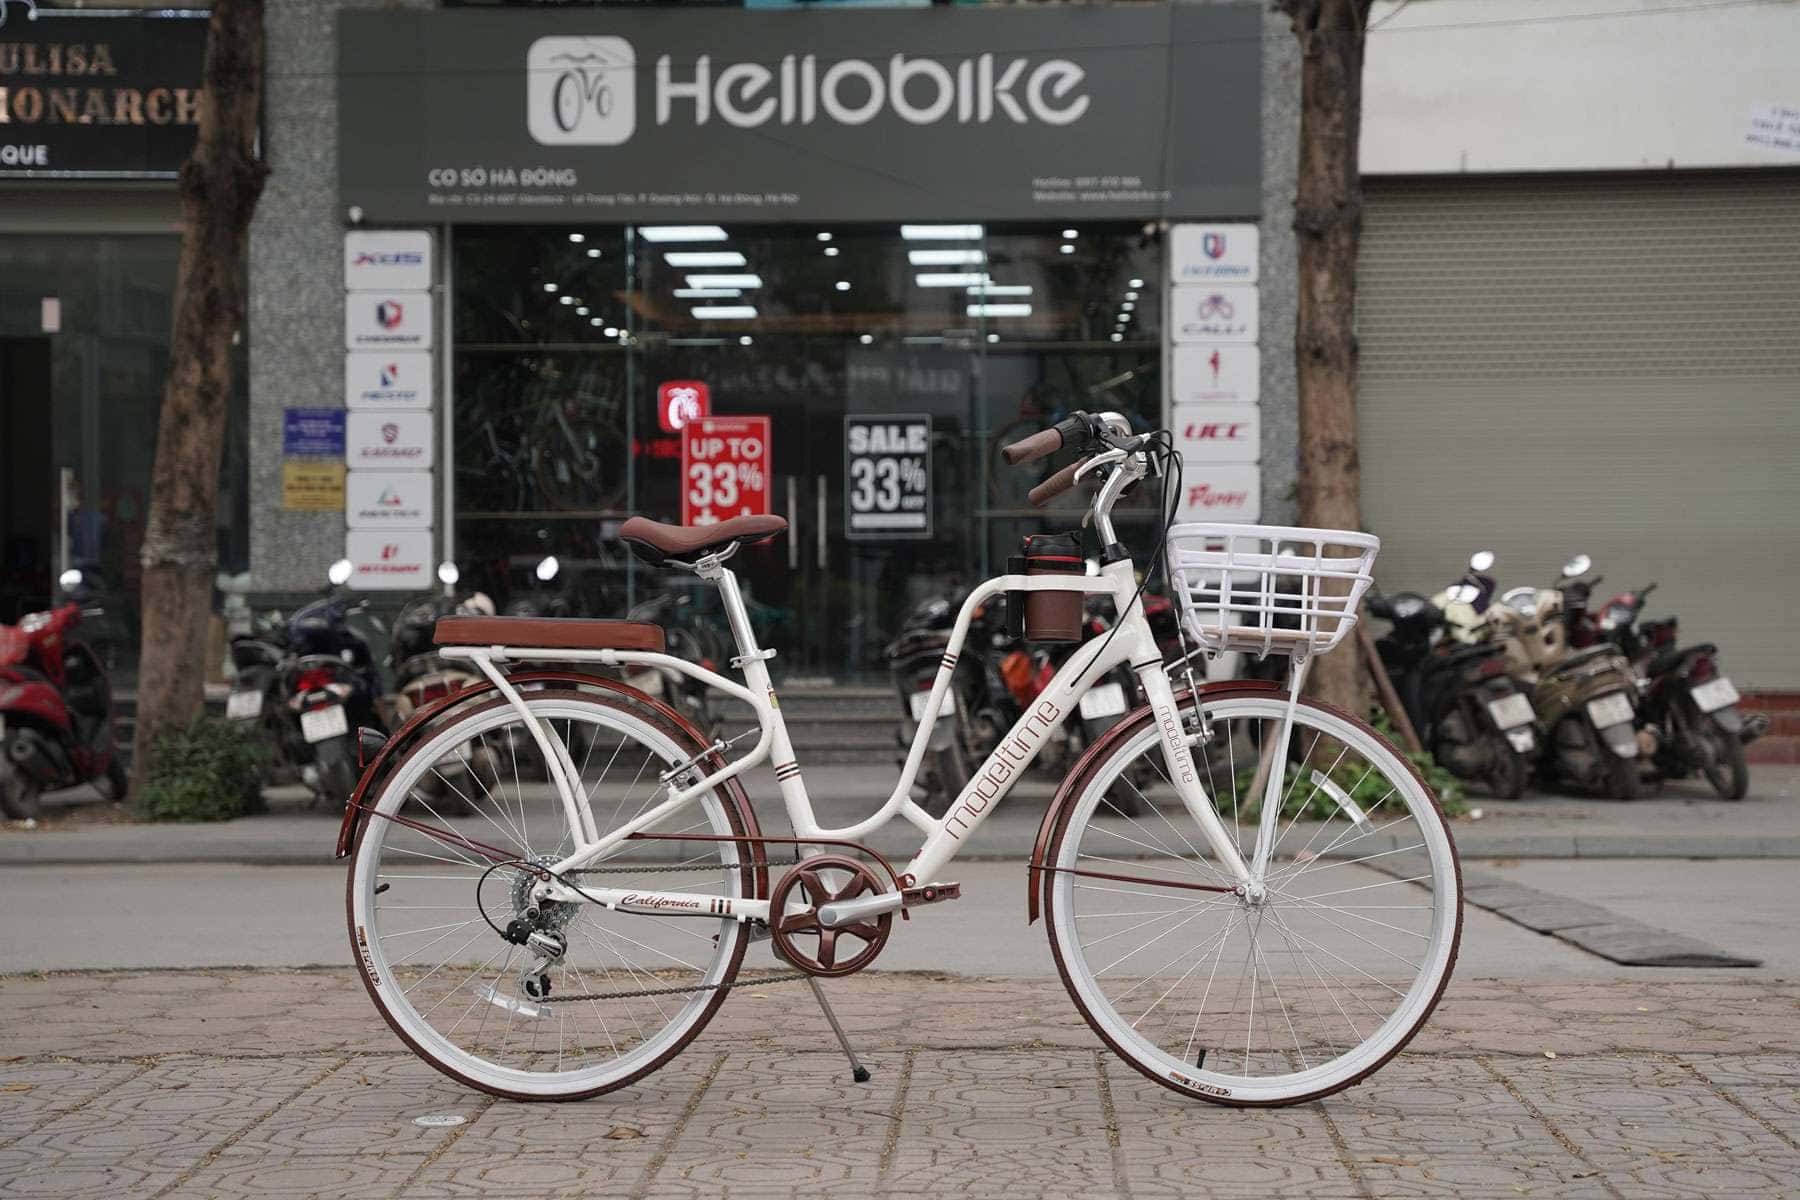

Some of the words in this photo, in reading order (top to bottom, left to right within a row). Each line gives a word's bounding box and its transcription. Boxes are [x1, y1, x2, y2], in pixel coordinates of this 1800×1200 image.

[0, 86, 205, 125] ONARCH
[690, 437, 724, 460] UP
[727, 437, 763, 460] TO
[849, 424, 928, 454] SALE
[689, 462, 763, 507] 33%
[850, 457, 926, 512] 33%
[944, 700, 1061, 840] modeltime
[621, 893, 700, 909] California
